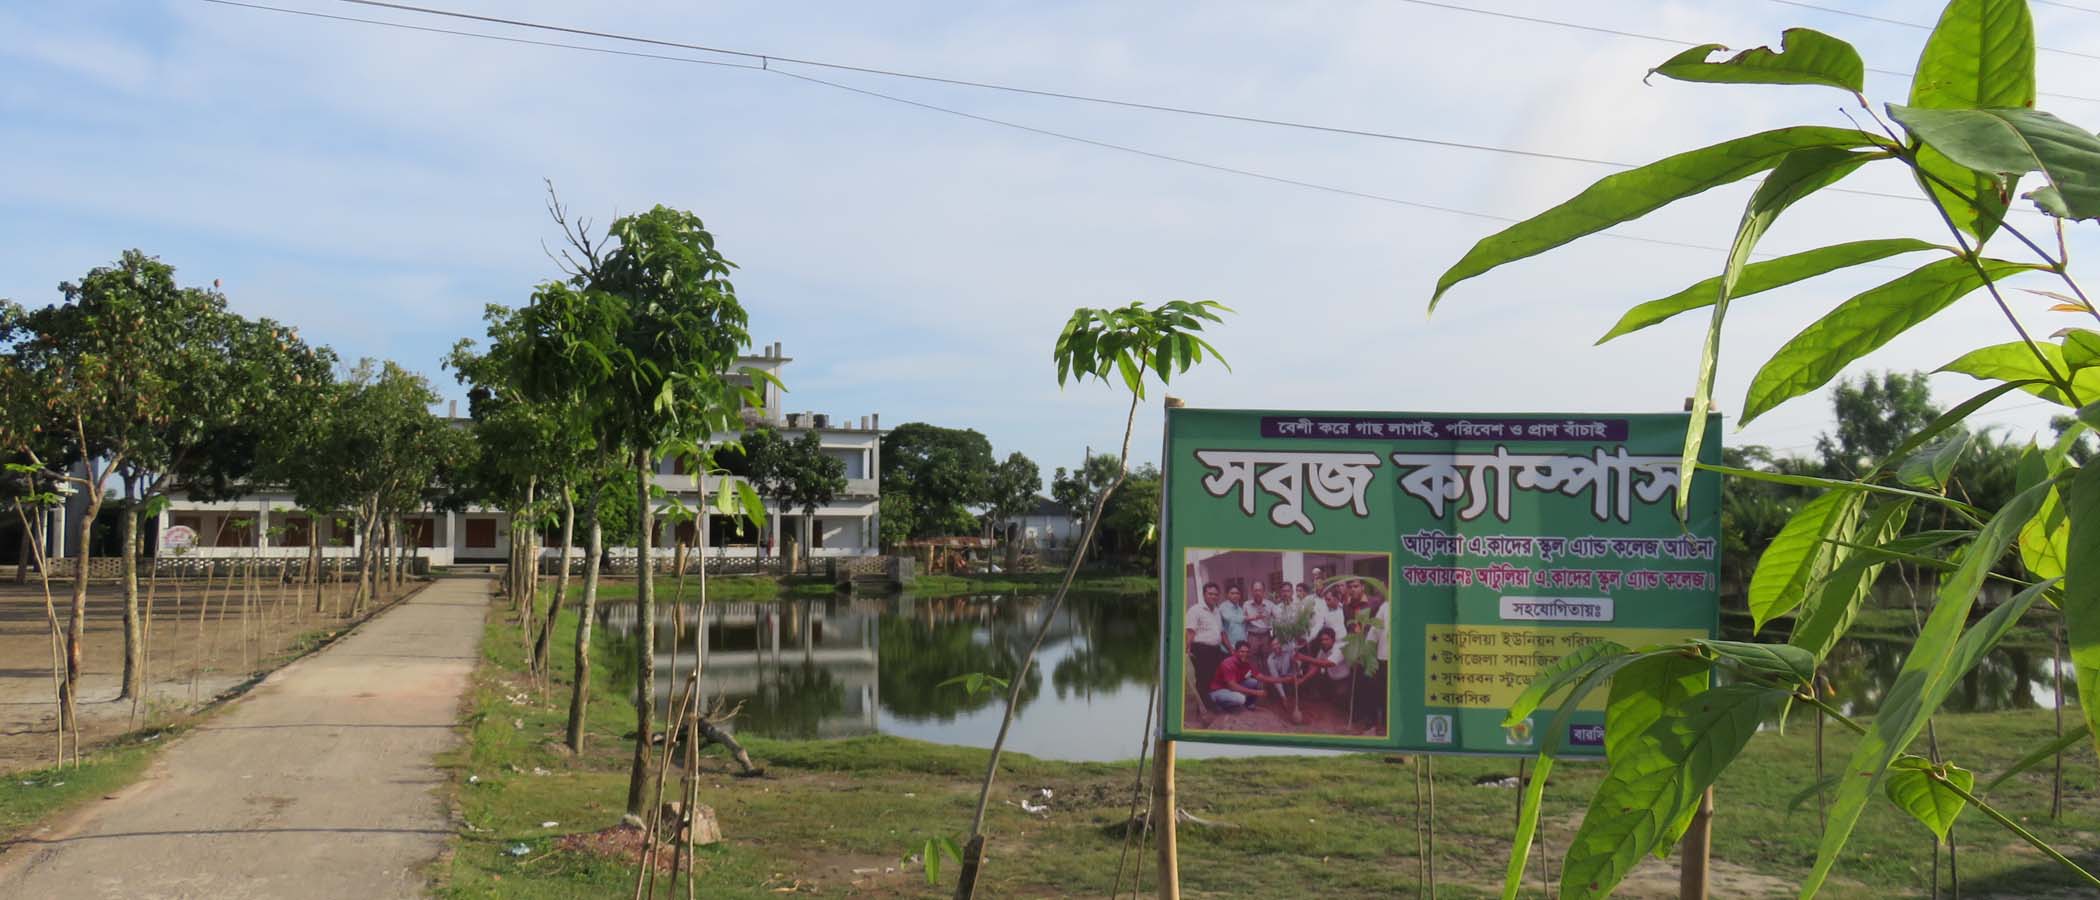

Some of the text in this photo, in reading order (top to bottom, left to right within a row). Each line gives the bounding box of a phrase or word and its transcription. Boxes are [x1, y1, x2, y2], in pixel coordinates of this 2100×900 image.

[1278, 418, 1608, 438] বেশী করে গাছ লাগাই, পরিবেশ ও প্রাণ বাঁচাই
[1193, 446, 1701, 534] সবুজ ক্যাম্পাস
[1402, 529, 1465, 560] আটুলিয়া
[1535, 535, 1567, 562] স্কুল
[1610, 537, 1660, 560] কলেজ
[1475, 562, 1530, 590] আটুলিয়া
[1595, 569, 1622, 592] স্কুল
[1442, 631, 1496, 648] আটুলিয়া
[1503, 631, 1555, 647] ইউনিয়ন
[1442, 651, 1498, 666] উপজেলা
[1442, 690, 1491, 704] বারসিক
[1573, 726, 1605, 741] বারসি
